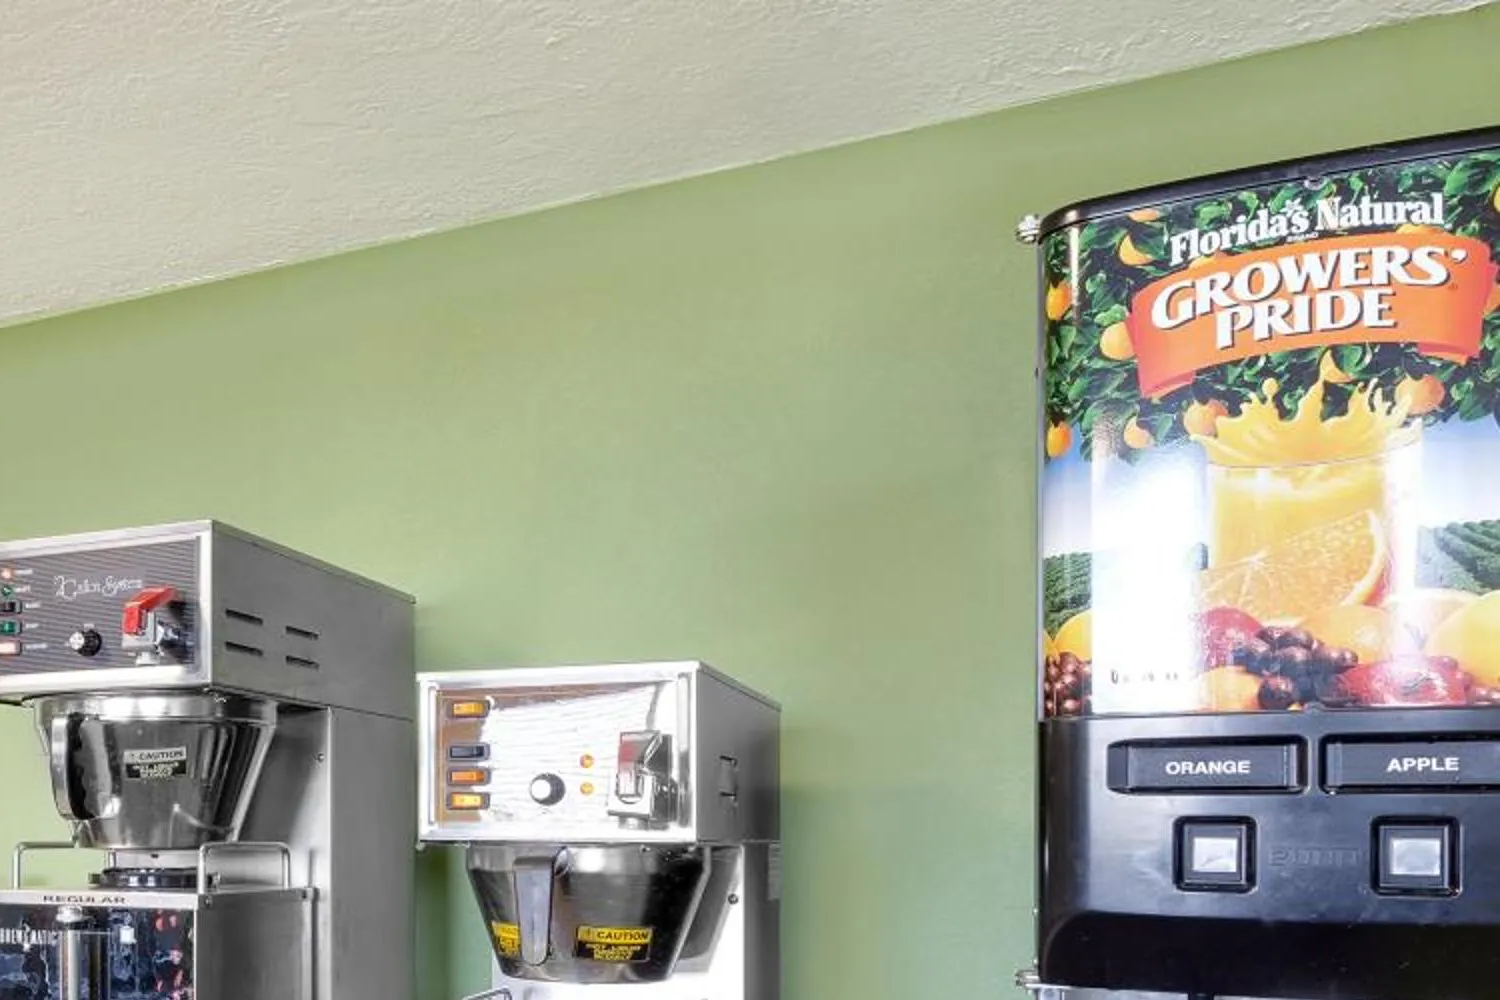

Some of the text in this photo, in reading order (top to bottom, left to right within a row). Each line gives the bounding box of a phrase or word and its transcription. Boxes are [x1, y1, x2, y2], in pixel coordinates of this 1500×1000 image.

[1168, 193, 1444, 267] Florida's Natural
[1151, 246, 1468, 331] GROWERS'
[1215, 287, 1396, 350] PRIDE
[1165, 760, 1252, 775] ORANGE
[1386, 757, 1460, 772] APPLE
[43, 895, 126, 904] REGULAR
[597, 928, 649, 941] CAUTION
